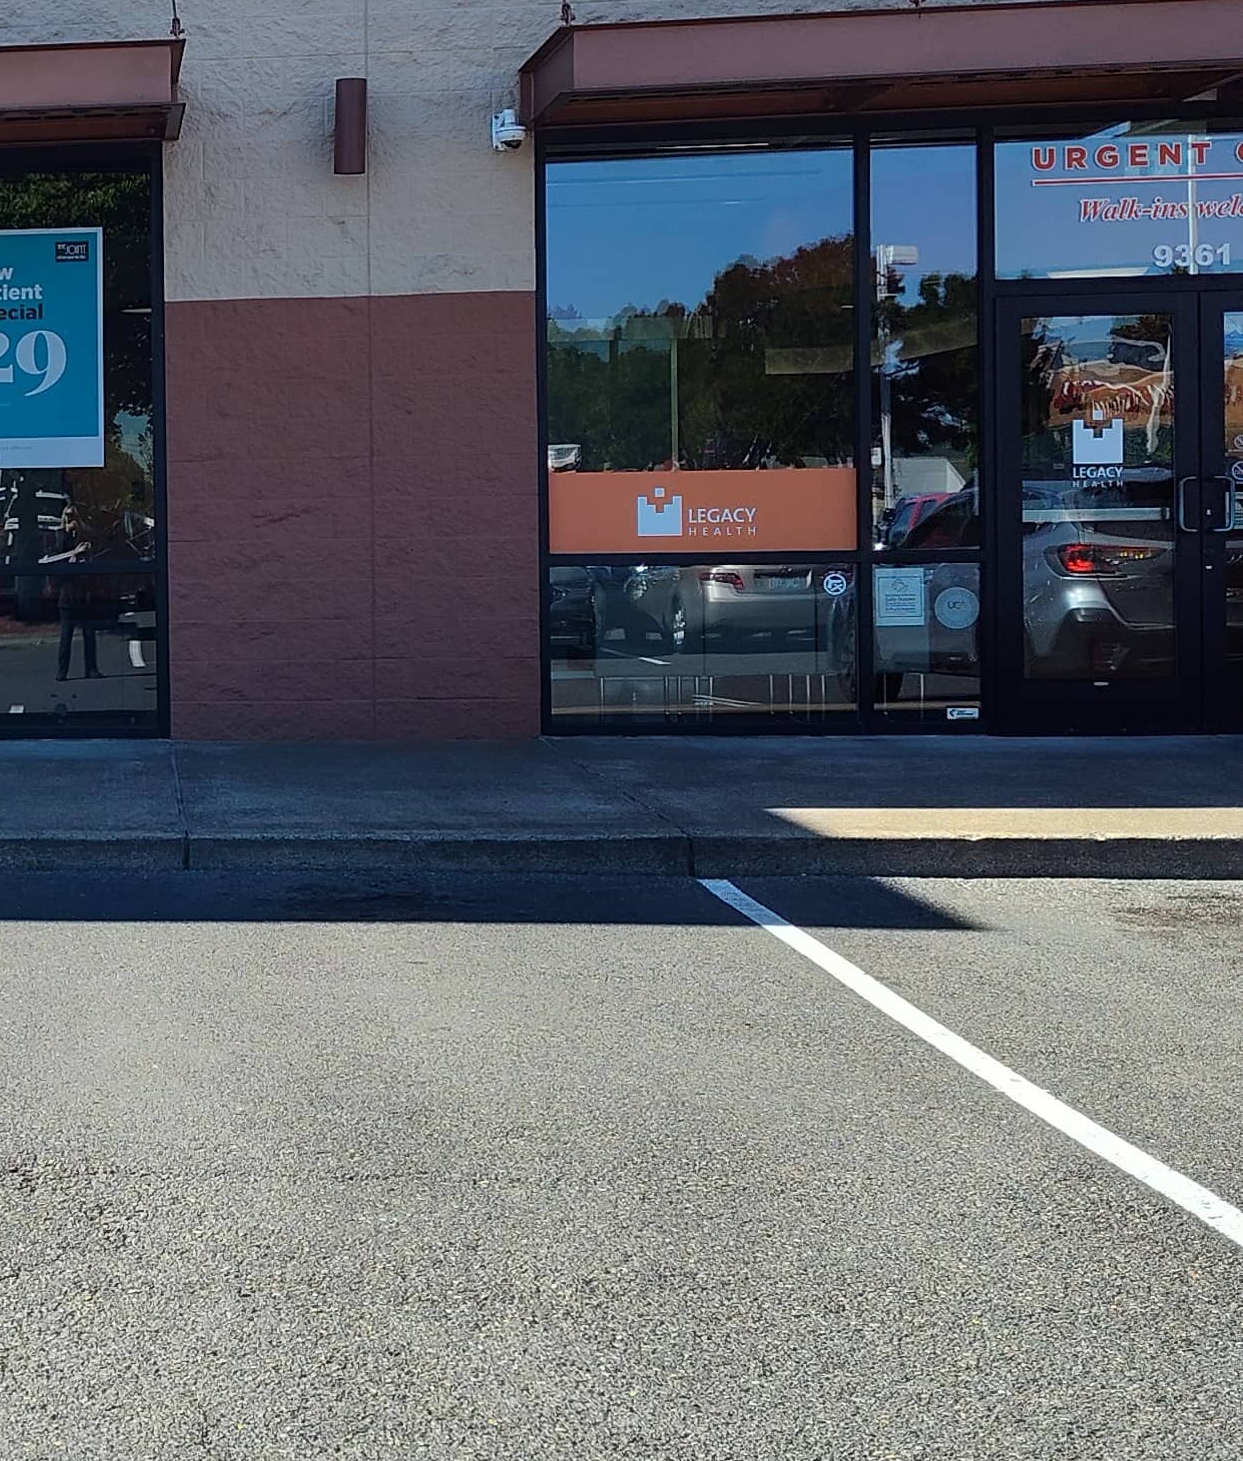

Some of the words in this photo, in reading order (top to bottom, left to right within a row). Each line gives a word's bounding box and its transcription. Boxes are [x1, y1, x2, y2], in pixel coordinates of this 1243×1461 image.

[1033, 142, 1212, 170] URGENT
[1080, 196, 1190, 222] Walk-ins
[1153, 243, 1231, 268] 9361
[1072, 466, 1124, 479] LEGACY
[1072, 479, 1124, 488] HEALTH
[687, 507, 757, 523] LEGACY
[687, 526, 757, 536] HEALTH
